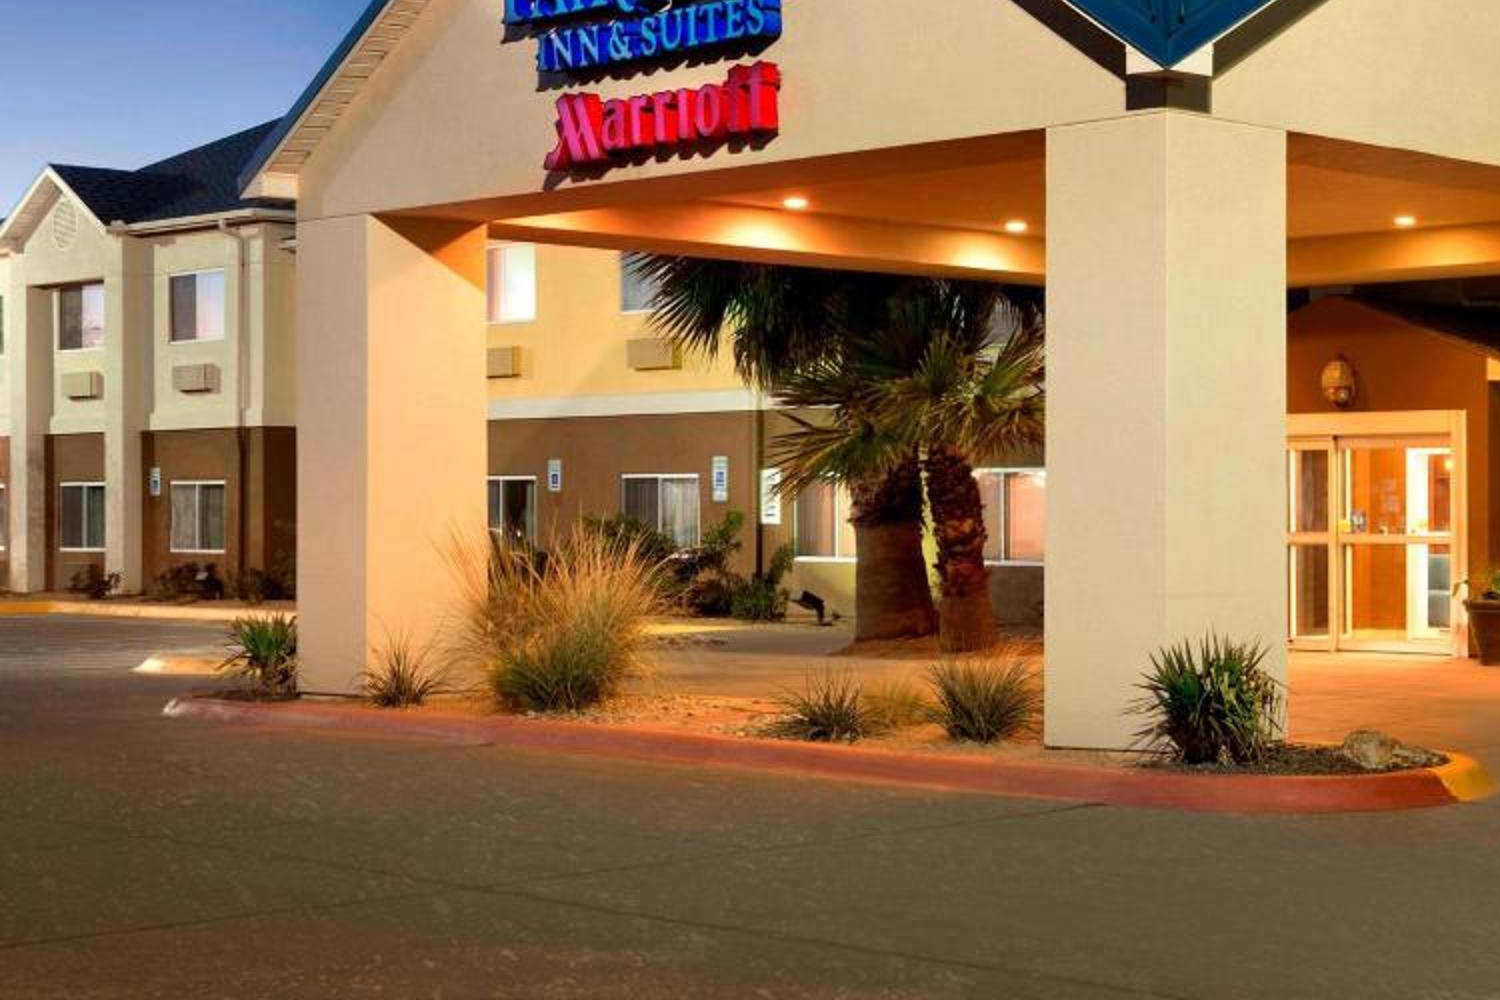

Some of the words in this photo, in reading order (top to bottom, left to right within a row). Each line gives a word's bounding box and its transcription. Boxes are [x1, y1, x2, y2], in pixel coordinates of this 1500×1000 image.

[537, 24, 601, 73] INN
[607, 20, 633, 62] &
[544, 61, 780, 171] Marriott
